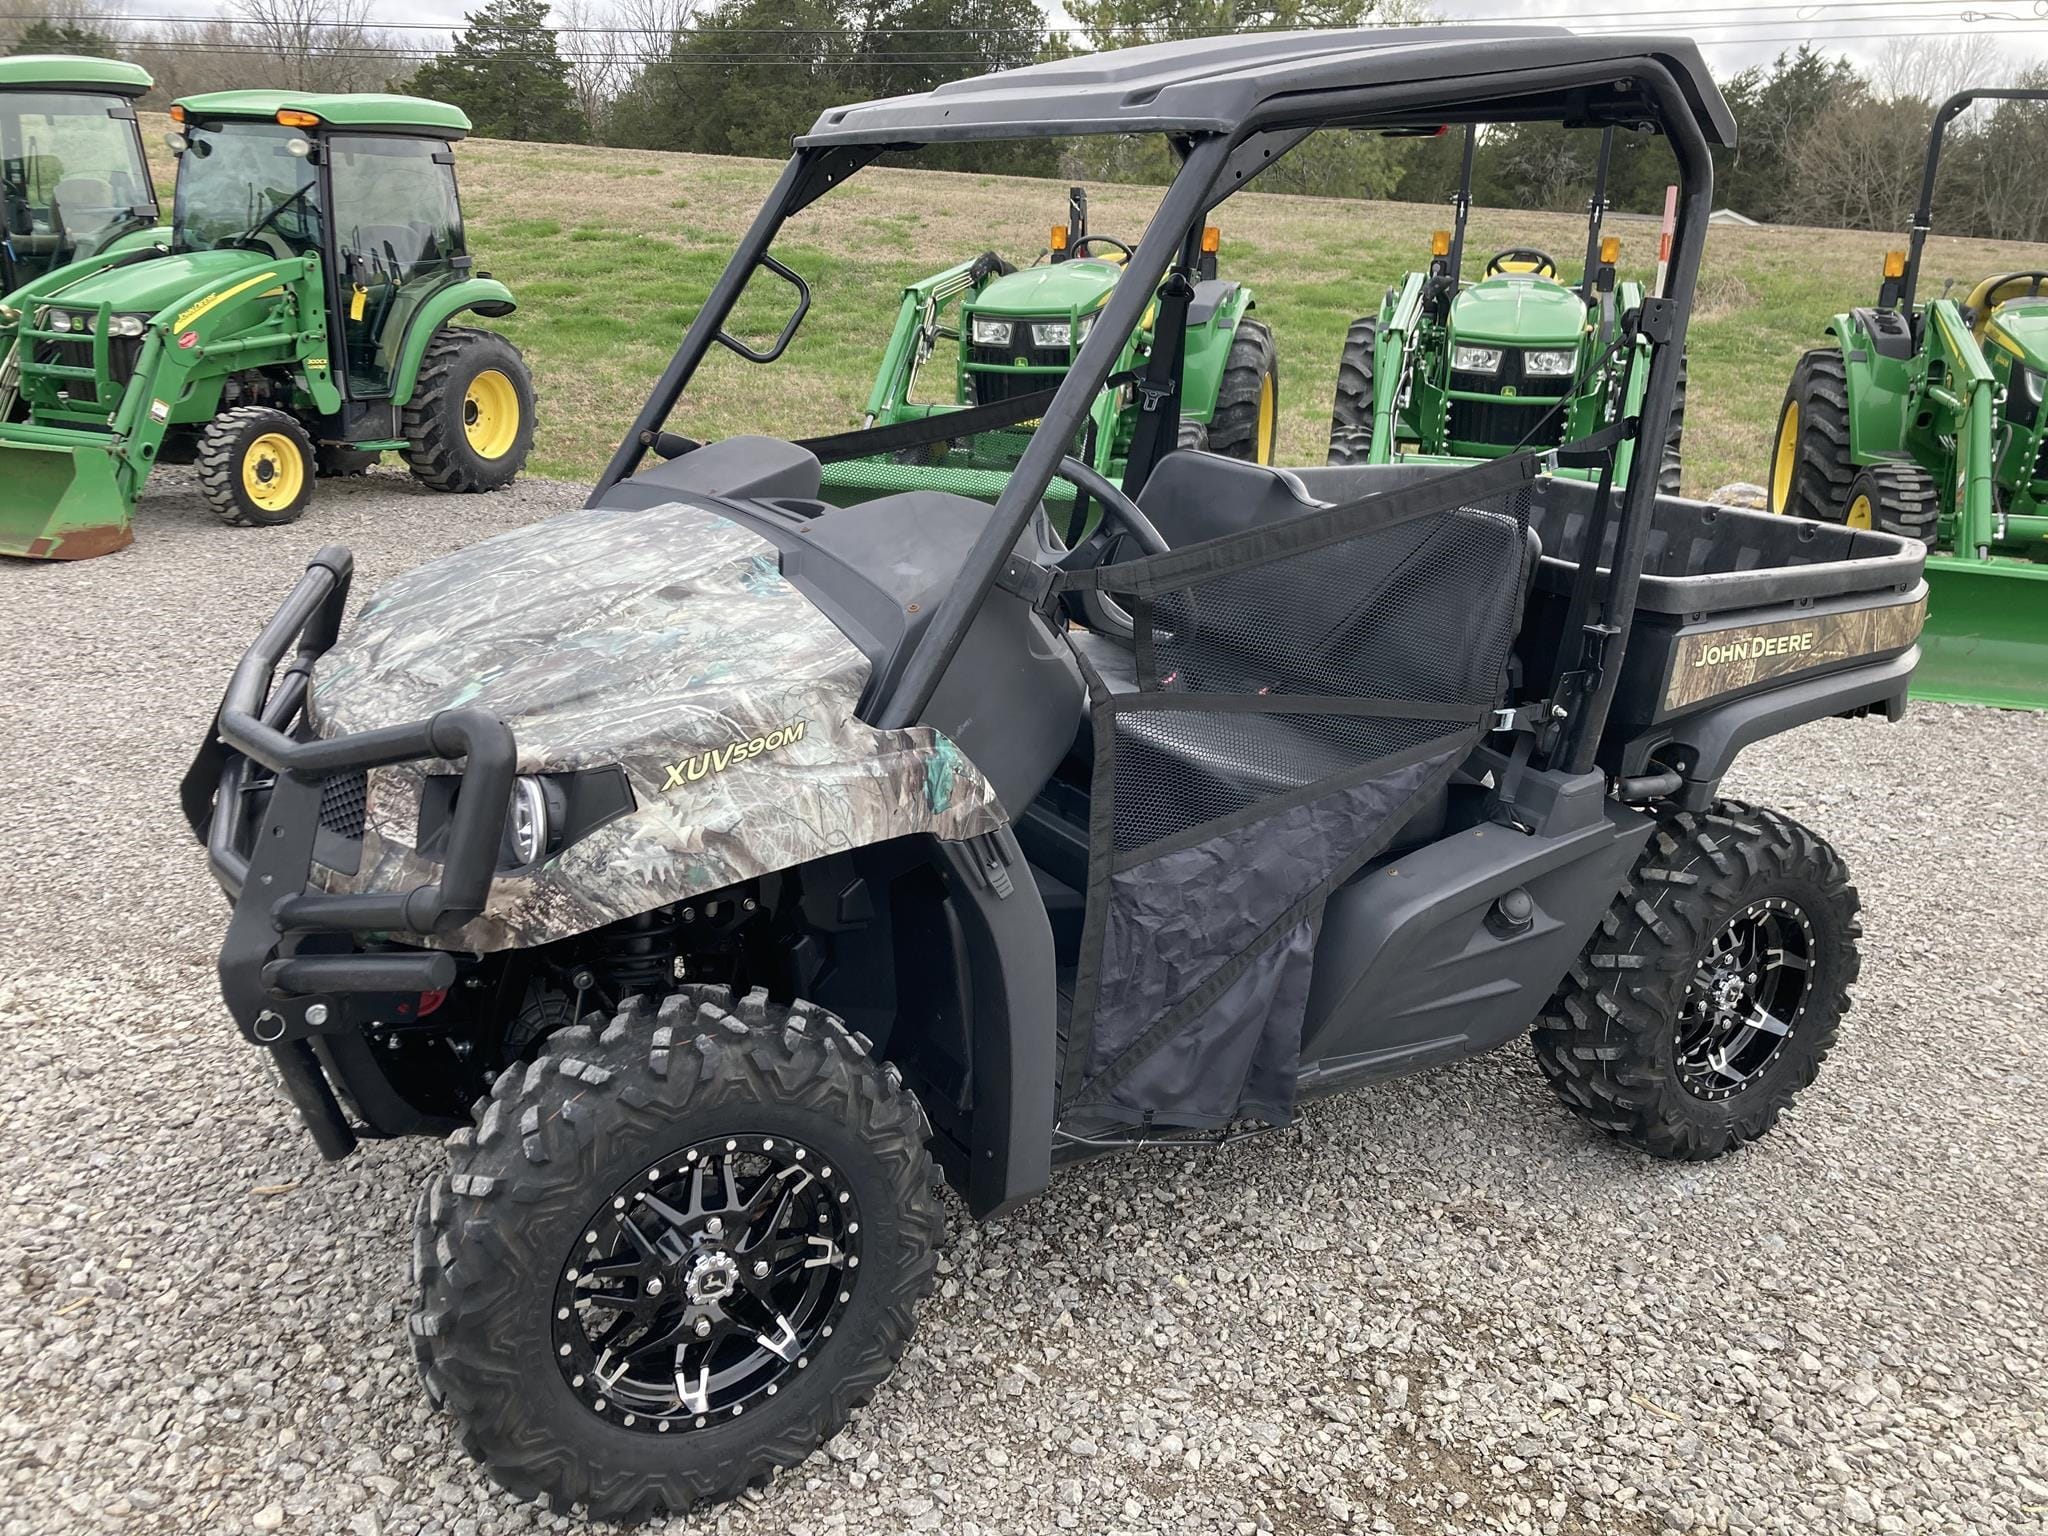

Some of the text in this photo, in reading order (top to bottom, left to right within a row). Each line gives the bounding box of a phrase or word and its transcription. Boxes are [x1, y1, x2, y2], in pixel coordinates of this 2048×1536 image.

[1694, 632, 1814, 668] JOHN DEERE
[659, 721, 806, 793] XUV590M
